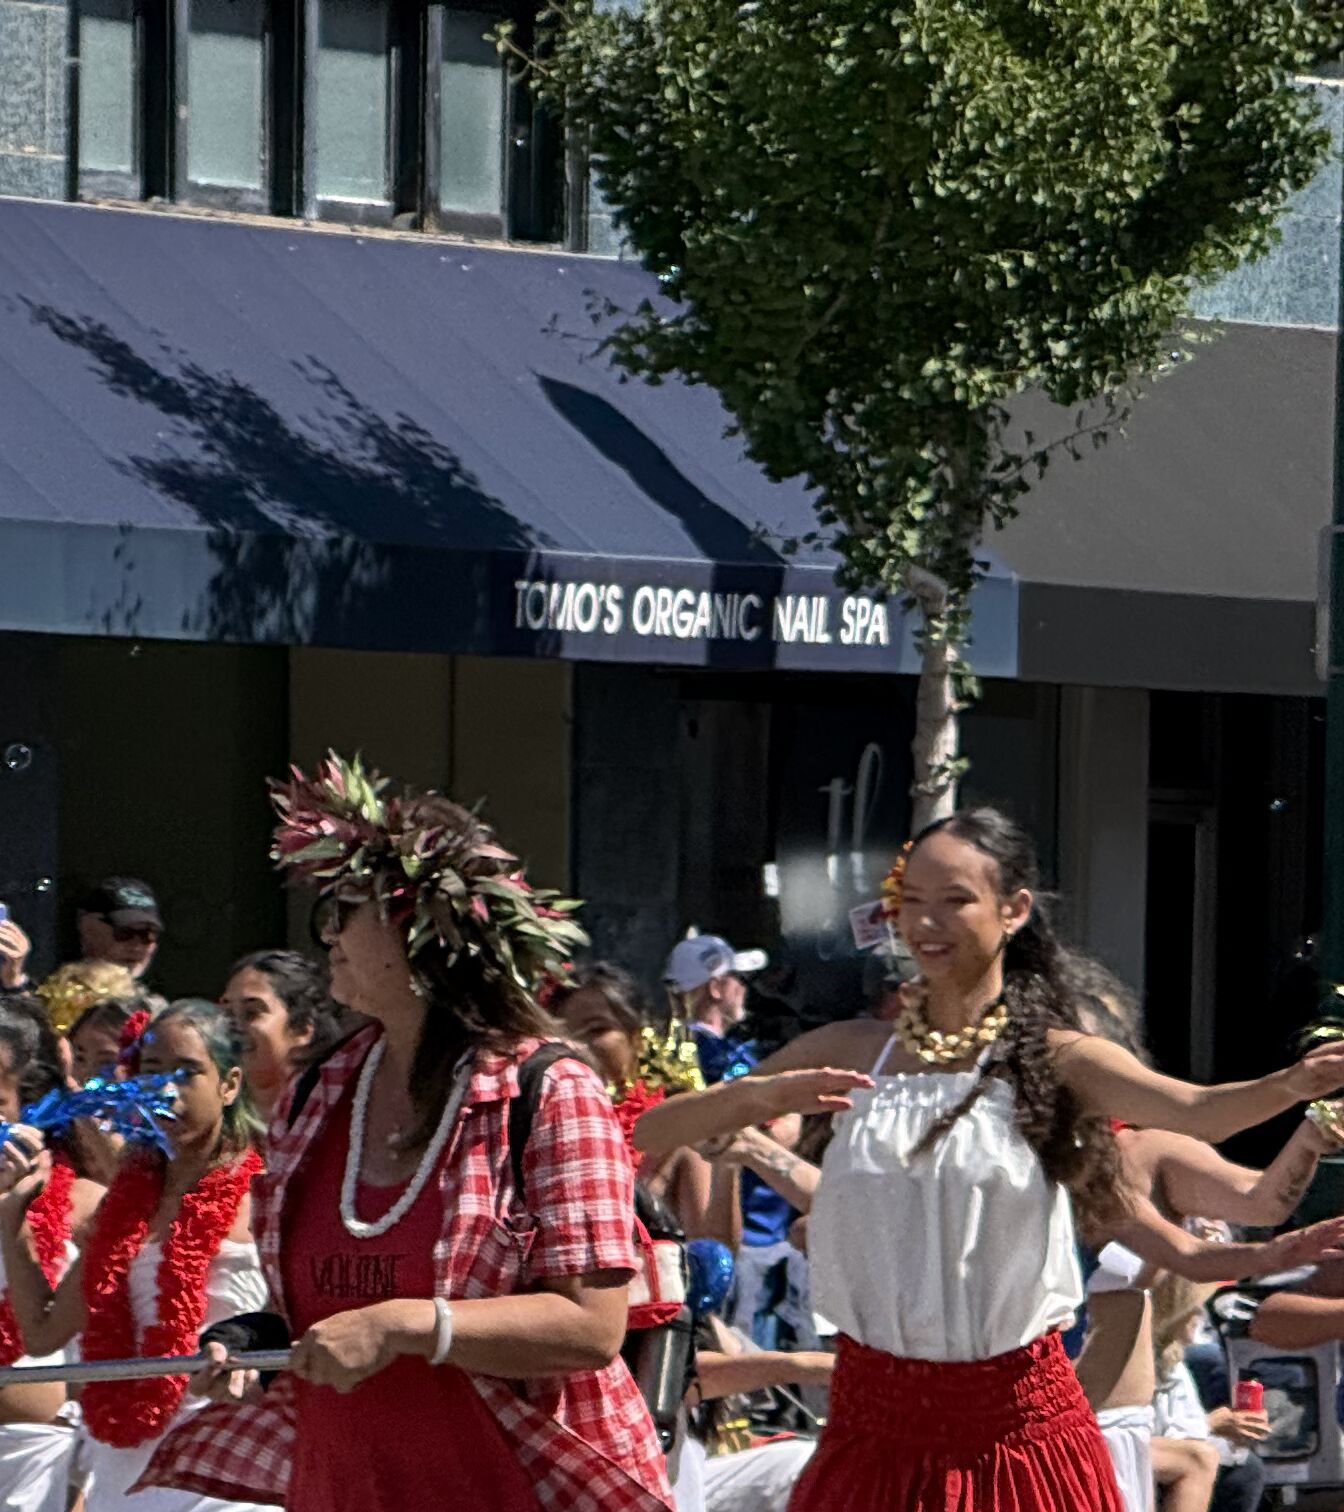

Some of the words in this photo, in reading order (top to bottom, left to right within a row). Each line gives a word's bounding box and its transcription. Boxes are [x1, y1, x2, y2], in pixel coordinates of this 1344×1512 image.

[514, 581, 623, 635] TOMO'S
[632, 586, 762, 641] ORGANIC
[773, 596, 831, 645] NAIL
[841, 597, 891, 646] SPA
